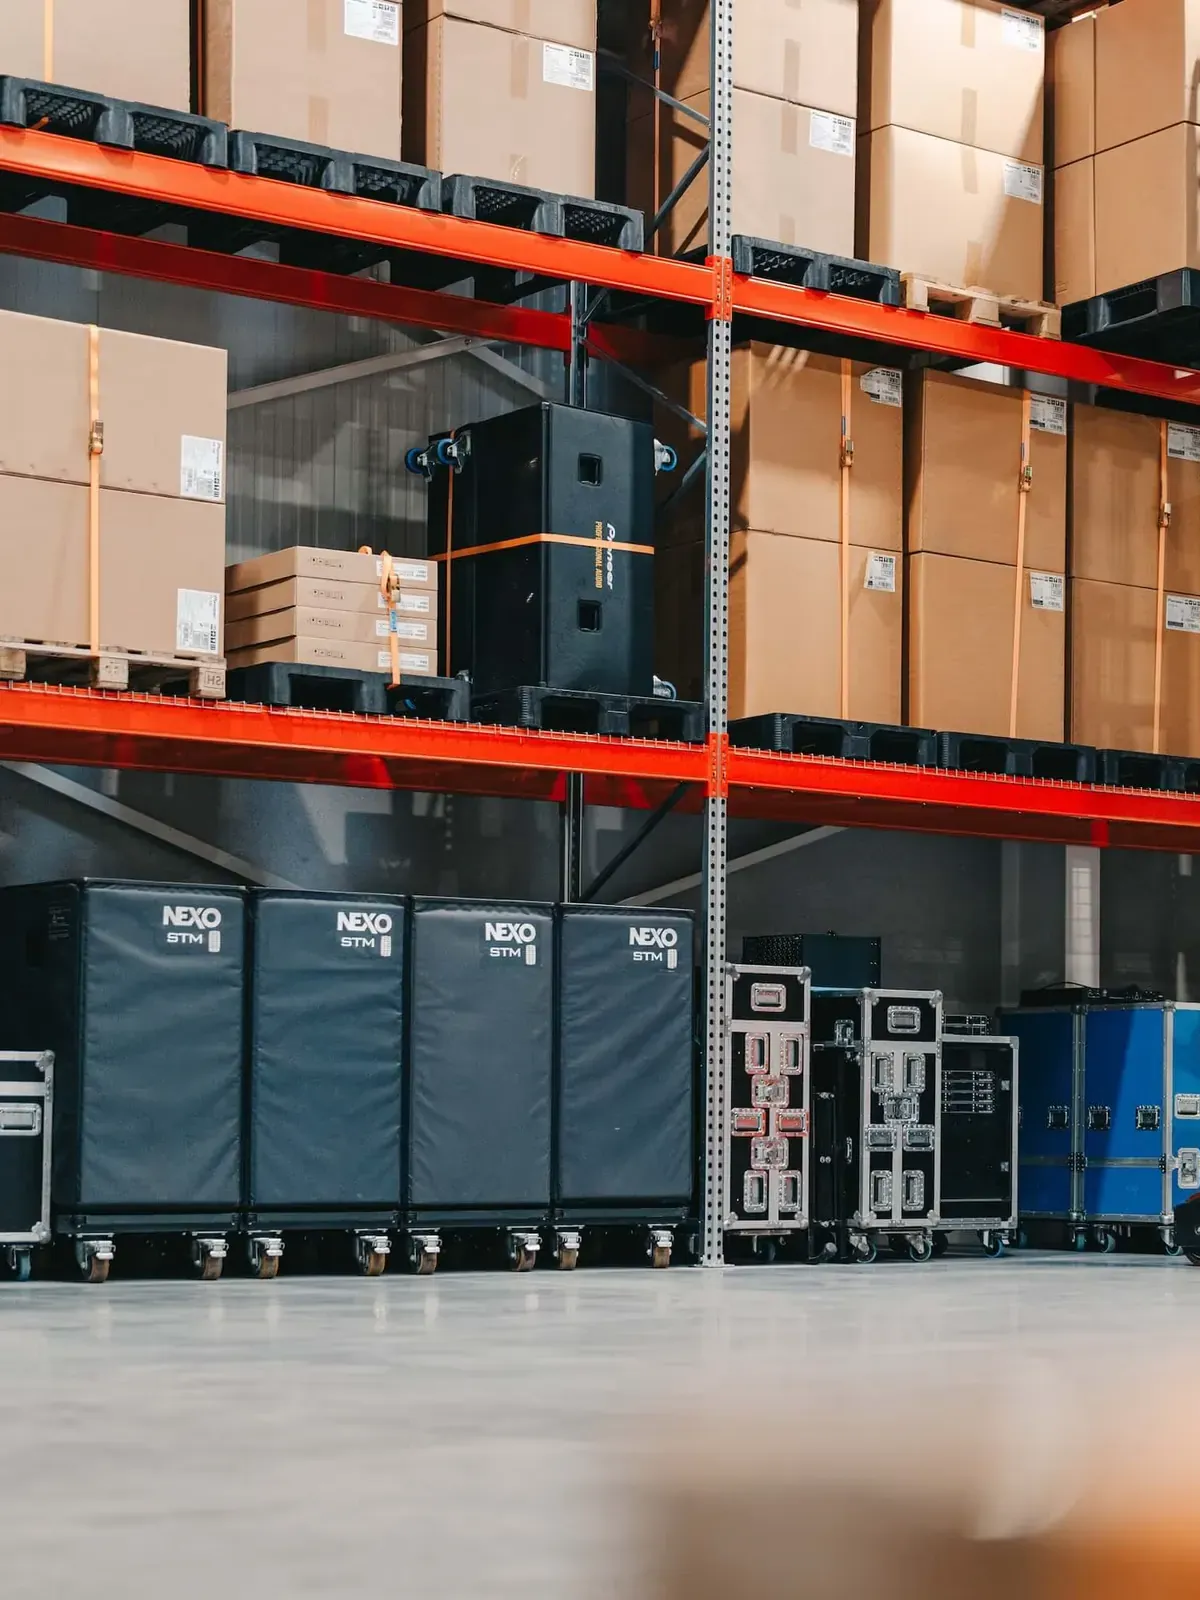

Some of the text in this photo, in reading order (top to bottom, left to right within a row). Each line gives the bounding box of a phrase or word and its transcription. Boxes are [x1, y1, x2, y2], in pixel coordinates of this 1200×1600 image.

[607, 523, 615, 590] Pineer
[162, 905, 222, 930] NEXO
[336, 911, 393, 935] NEXO
[166, 931, 203, 945] STM
[340, 936, 375, 948] STM
[484, 922, 537, 944] NEXO
[628, 926, 678, 949] NEXO
[489, 946, 522, 958] STM
[632, 951, 663, 962] STM
